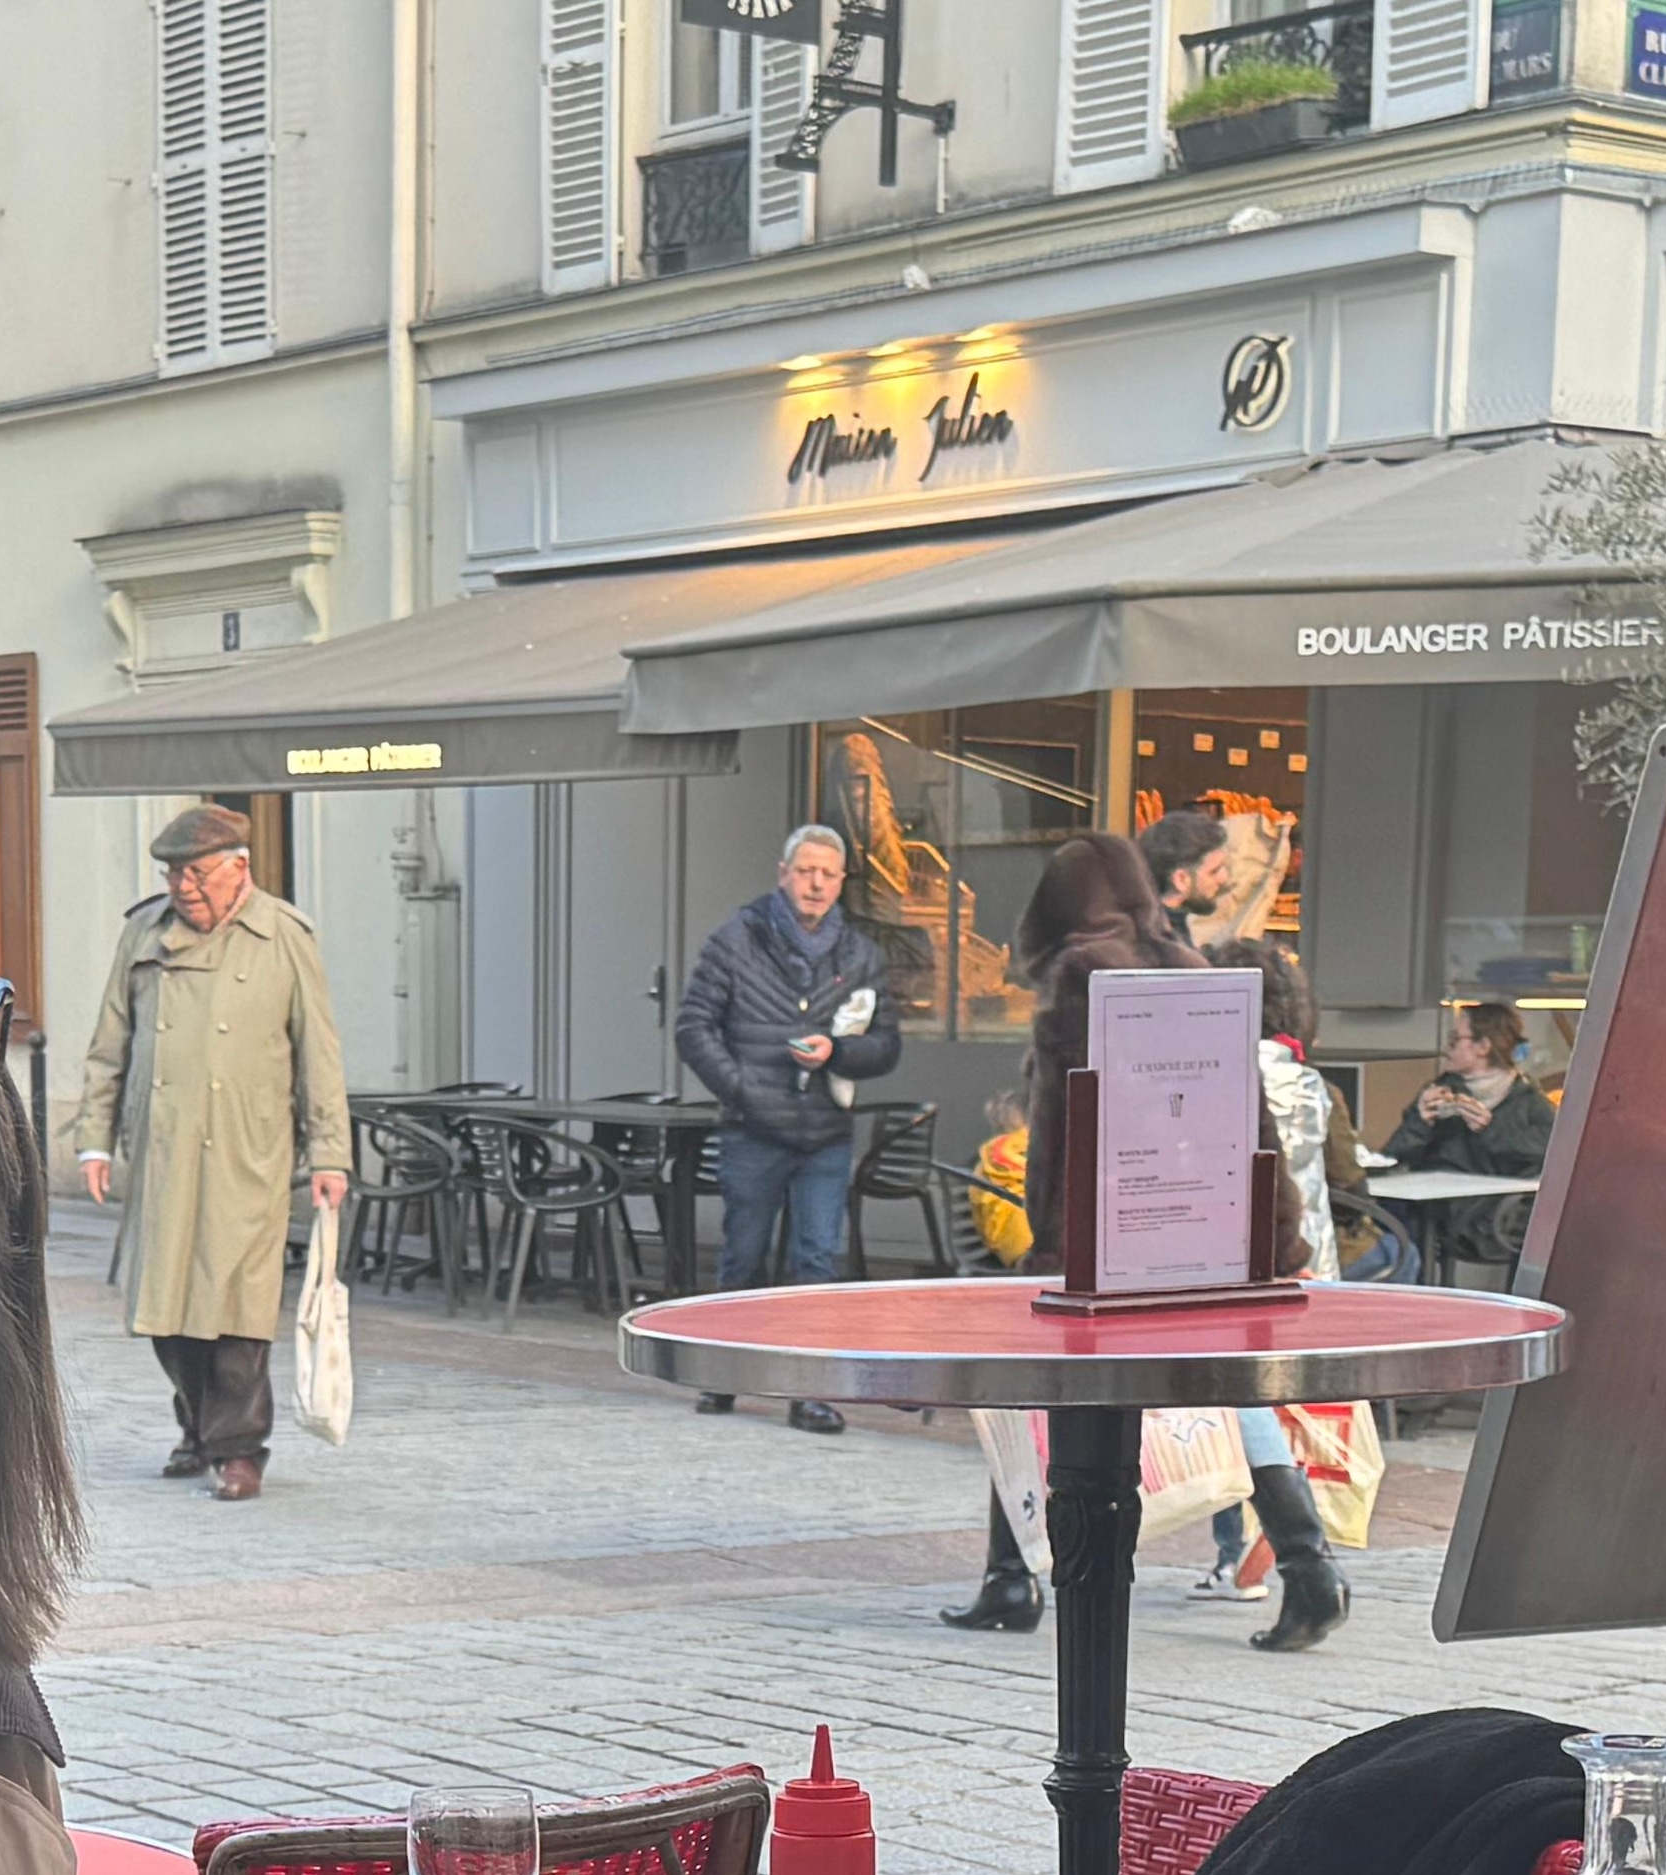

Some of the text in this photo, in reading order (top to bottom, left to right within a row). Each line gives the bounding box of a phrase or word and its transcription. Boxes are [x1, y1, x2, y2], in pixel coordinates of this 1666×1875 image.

[787, 371, 1014, 485] Maison Julien
[1296, 615, 1666, 656] BOULANGER PÂTISSIER
